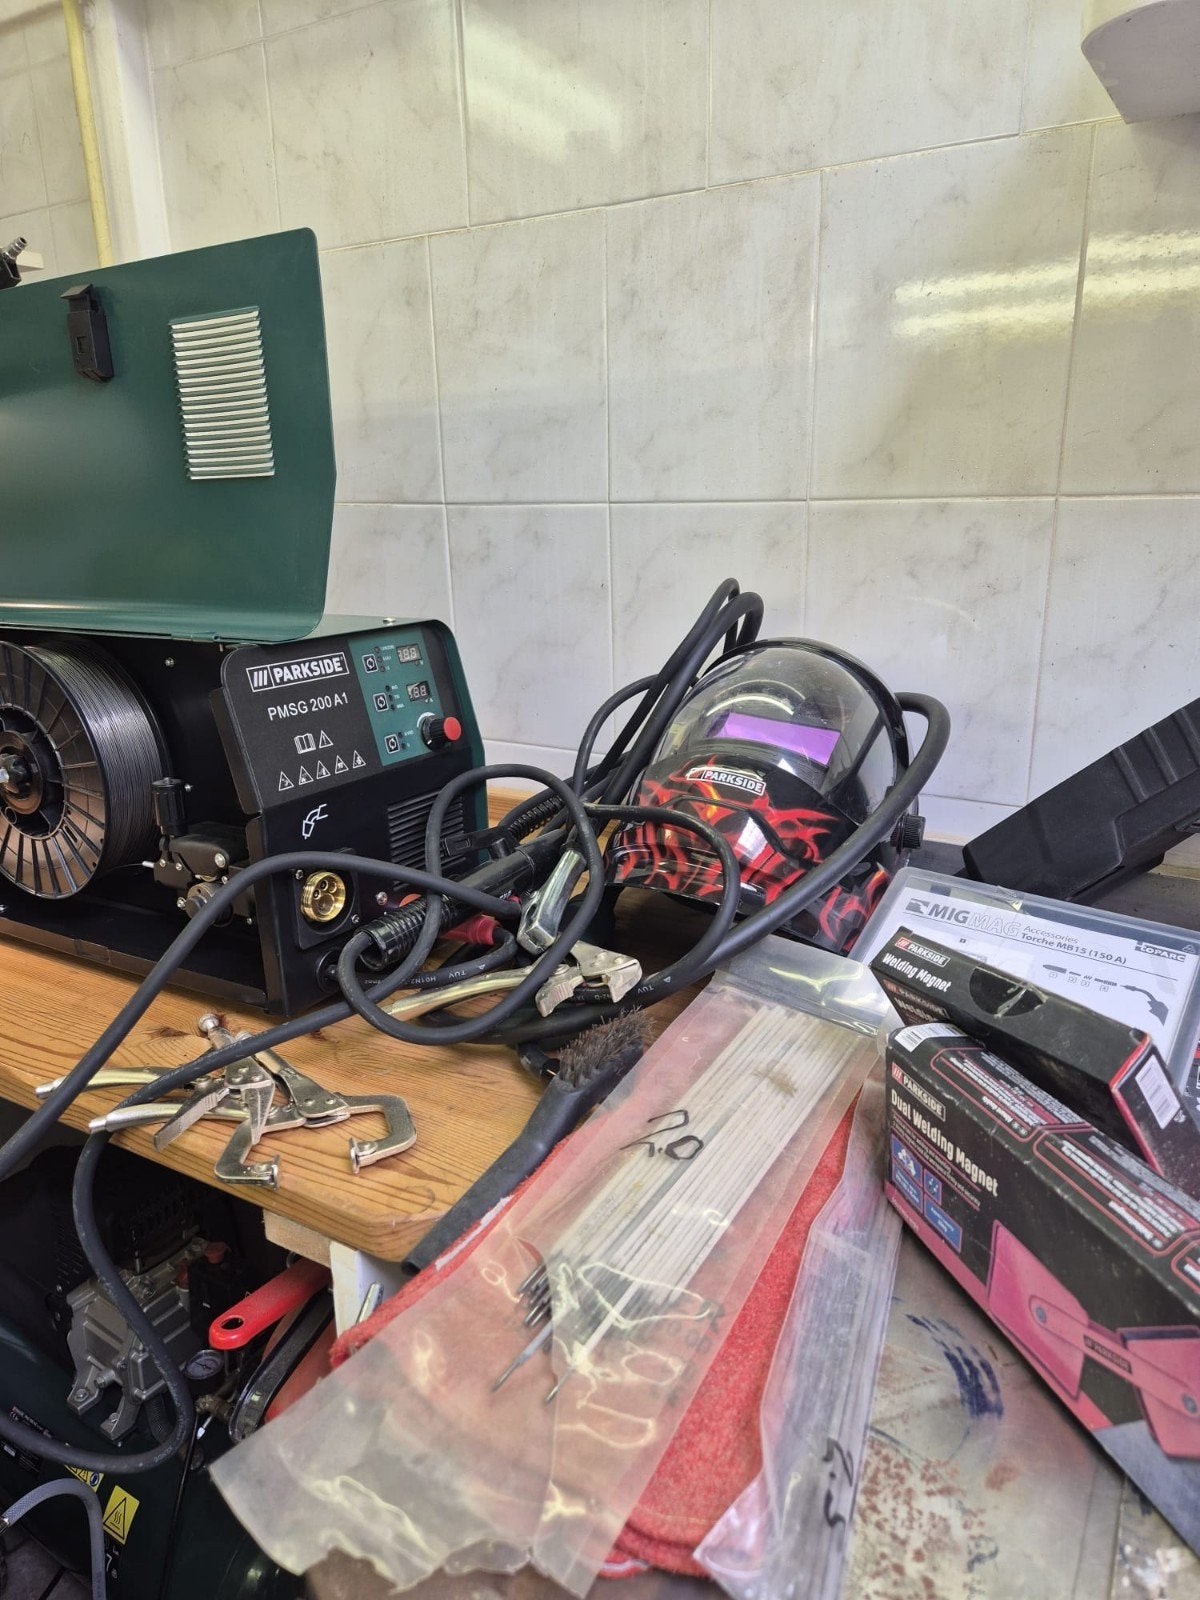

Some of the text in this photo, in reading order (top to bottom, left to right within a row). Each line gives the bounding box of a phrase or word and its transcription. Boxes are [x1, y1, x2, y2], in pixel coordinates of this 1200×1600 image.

[272, 656, 344, 684] PARKSIDE
[267, 691, 349, 721] PMSG 200 A1
[704, 769, 763, 793] PARKSIDE
[1021, 932, 1127, 965] Torche MB15 (150 A)
[1023, 925, 1079, 944] Accessories
[907, 943, 946, 965] PARKSIDE
[881, 952, 952, 993] Welding Magnet
[902, 1074, 943, 1116] PARKSIDE
[890, 1088, 912, 1121] Dual
[912, 1108, 955, 1161] Welding
[955, 1147, 998, 1197] Magnet
